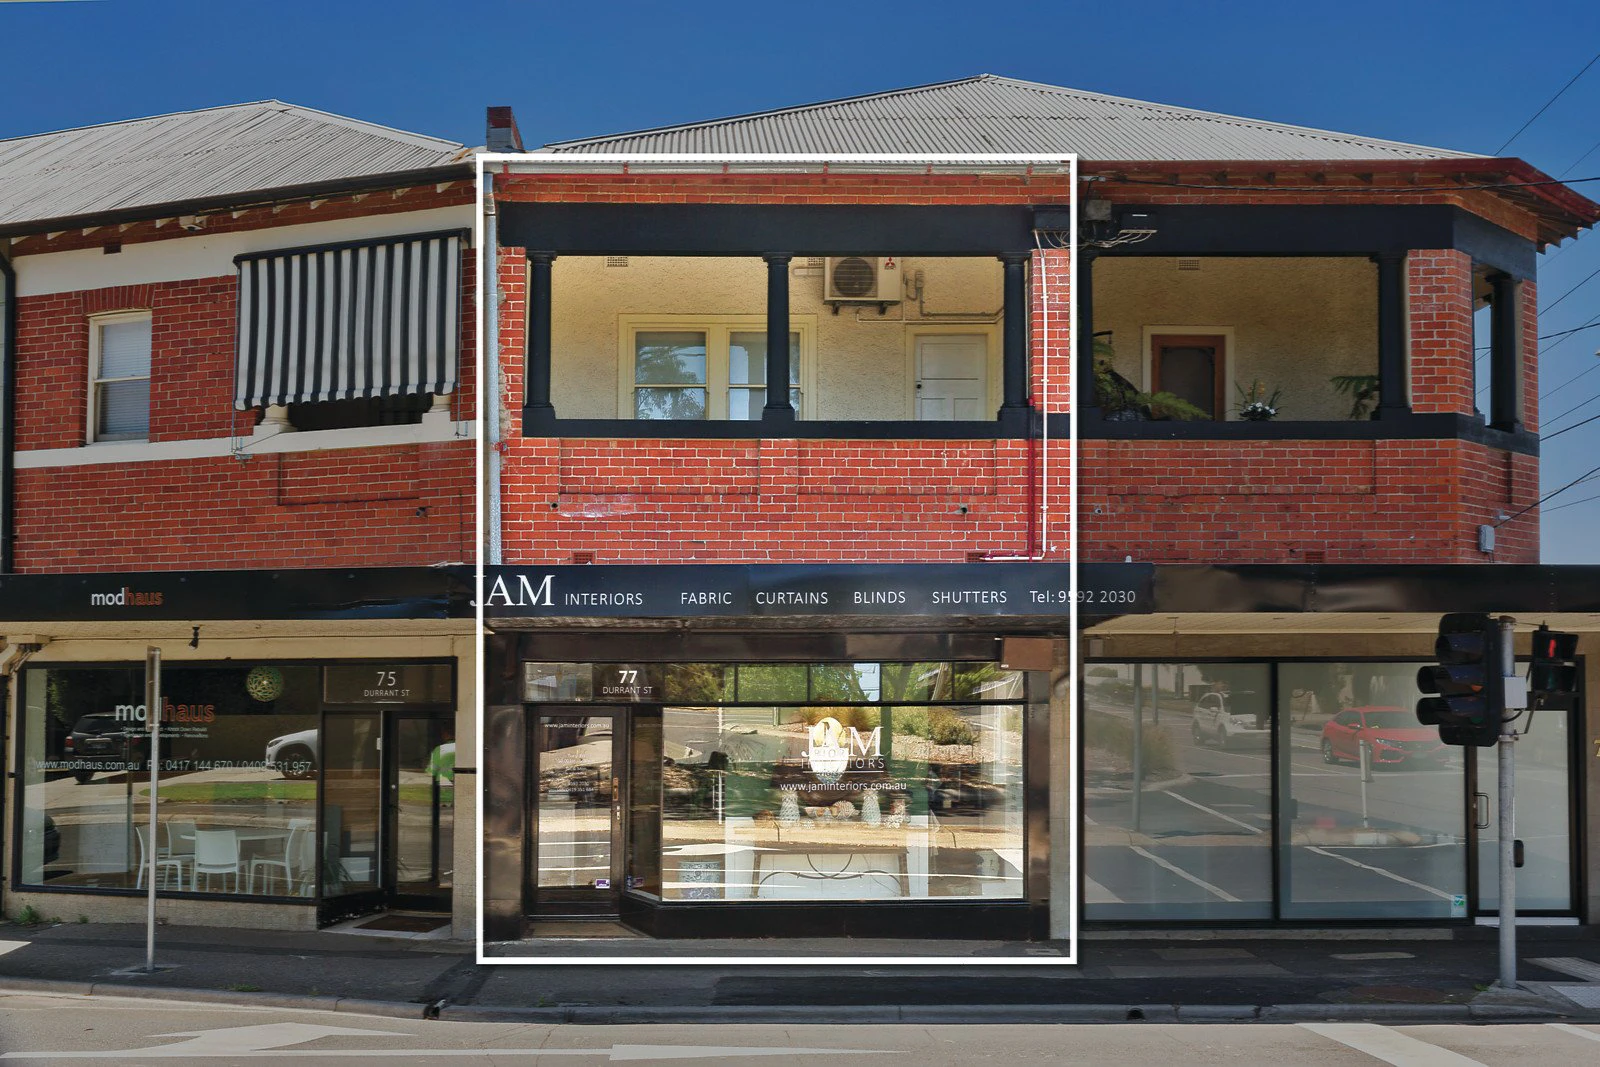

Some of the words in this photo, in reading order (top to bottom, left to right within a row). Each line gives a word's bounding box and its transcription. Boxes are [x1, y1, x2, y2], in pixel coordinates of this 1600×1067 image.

[91, 586, 164, 606] modhaus
[565, 592, 643, 606] INTERIORS
[680, 591, 732, 605] FABRIC
[755, 591, 829, 605] CURTAINS
[853, 591, 906, 604] BLINDS
[932, 590, 1007, 604] SHUTTERS
[1029, 590, 1055, 603] Tel:
[1100, 590, 1136, 603] 2030
[377, 671, 396, 686] 75
[618, 670, 638, 684] 77
[364, 689, 399, 697] DURRANT
[401, 689, 411, 697] ST
[602, 686, 641, 694] DURRANT
[643, 686, 653, 694] ST
[115, 696, 215, 722] mohaus
[36, 759, 140, 771] www.modhaus.com.au
[292, 761, 312, 772] 957
[780, 780, 907, 792] www.jaminteriors.com.au
